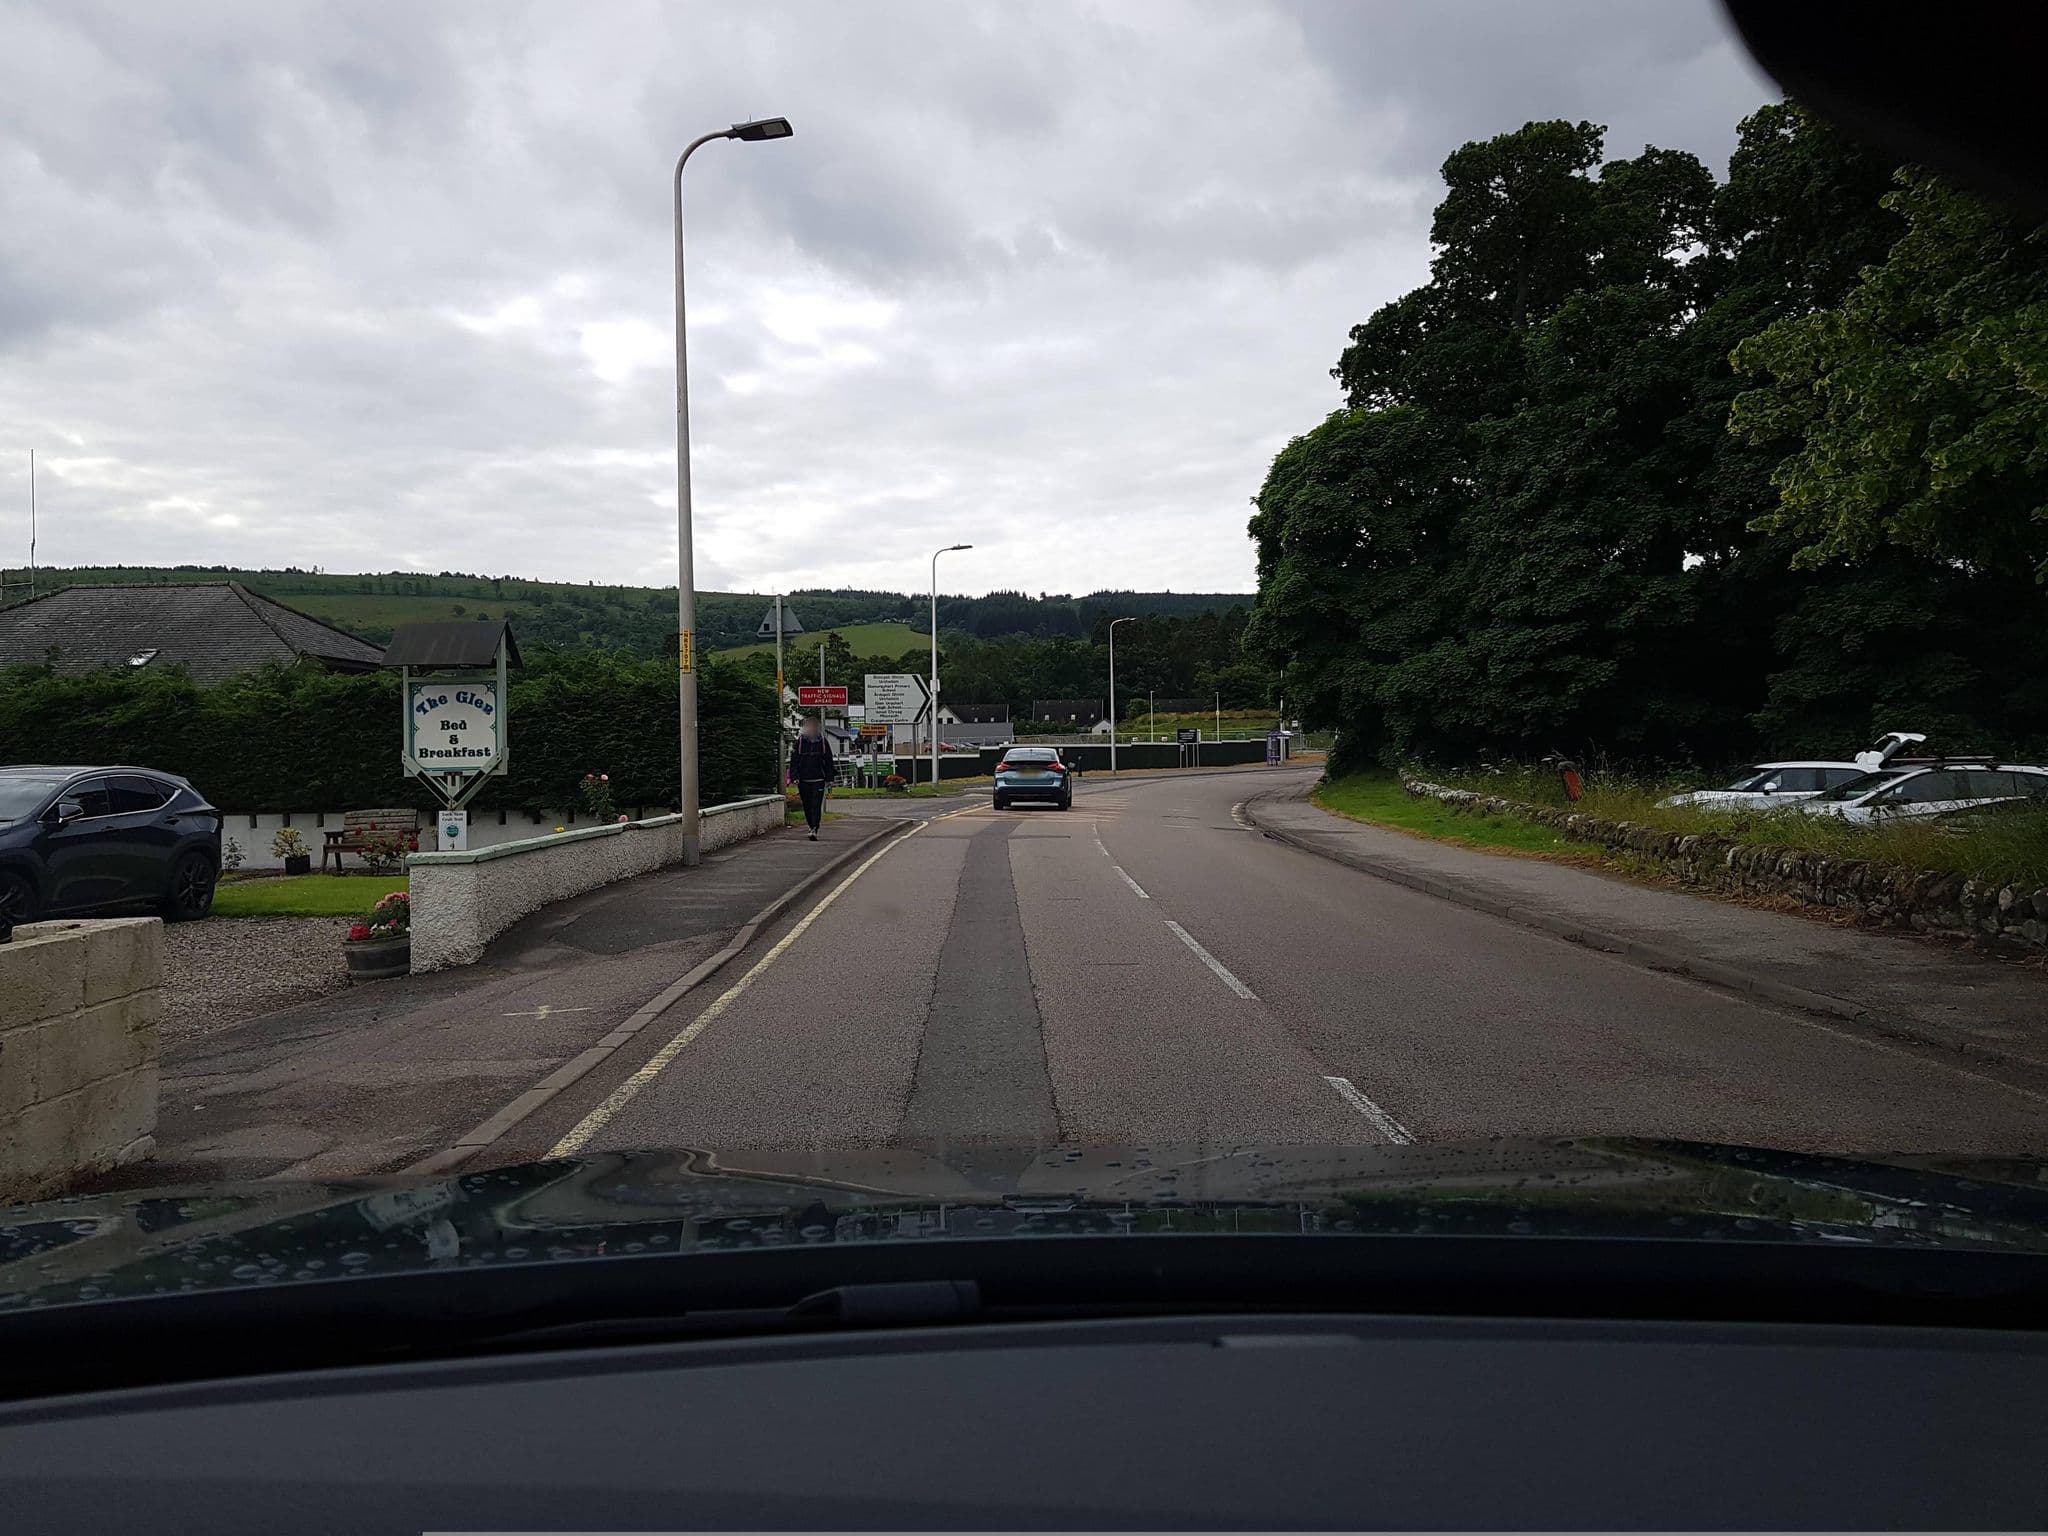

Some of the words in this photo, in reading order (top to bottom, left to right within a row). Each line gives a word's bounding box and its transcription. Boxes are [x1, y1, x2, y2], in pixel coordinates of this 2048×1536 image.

[415, 695, 448, 715] The
[455, 691, 494, 715] Glen
[440, 720, 467, 731] Bed
[449, 734, 459, 744] &
[418, 747, 492, 758] Breakfast
